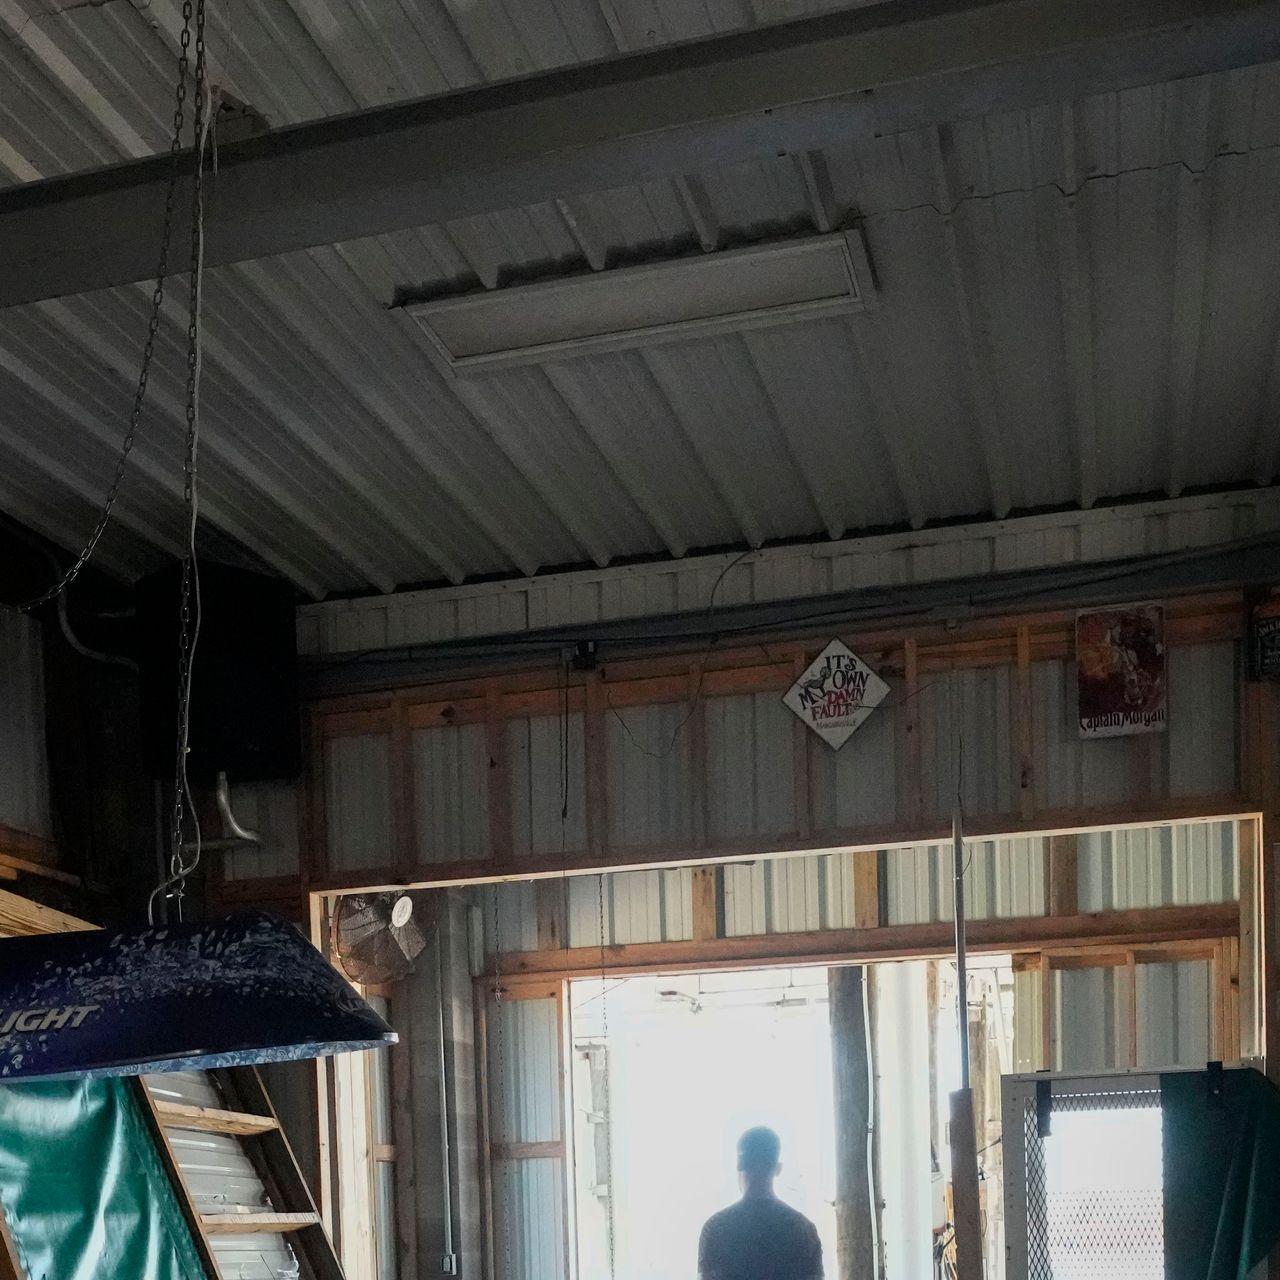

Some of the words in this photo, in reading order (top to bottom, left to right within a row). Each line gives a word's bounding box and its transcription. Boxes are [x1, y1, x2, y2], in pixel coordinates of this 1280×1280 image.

[824, 654, 858, 671] IT'S
[832, 669, 870, 690] OWN
[827, 687, 866, 704] DAMN
[811, 704, 852, 721] FAULT
